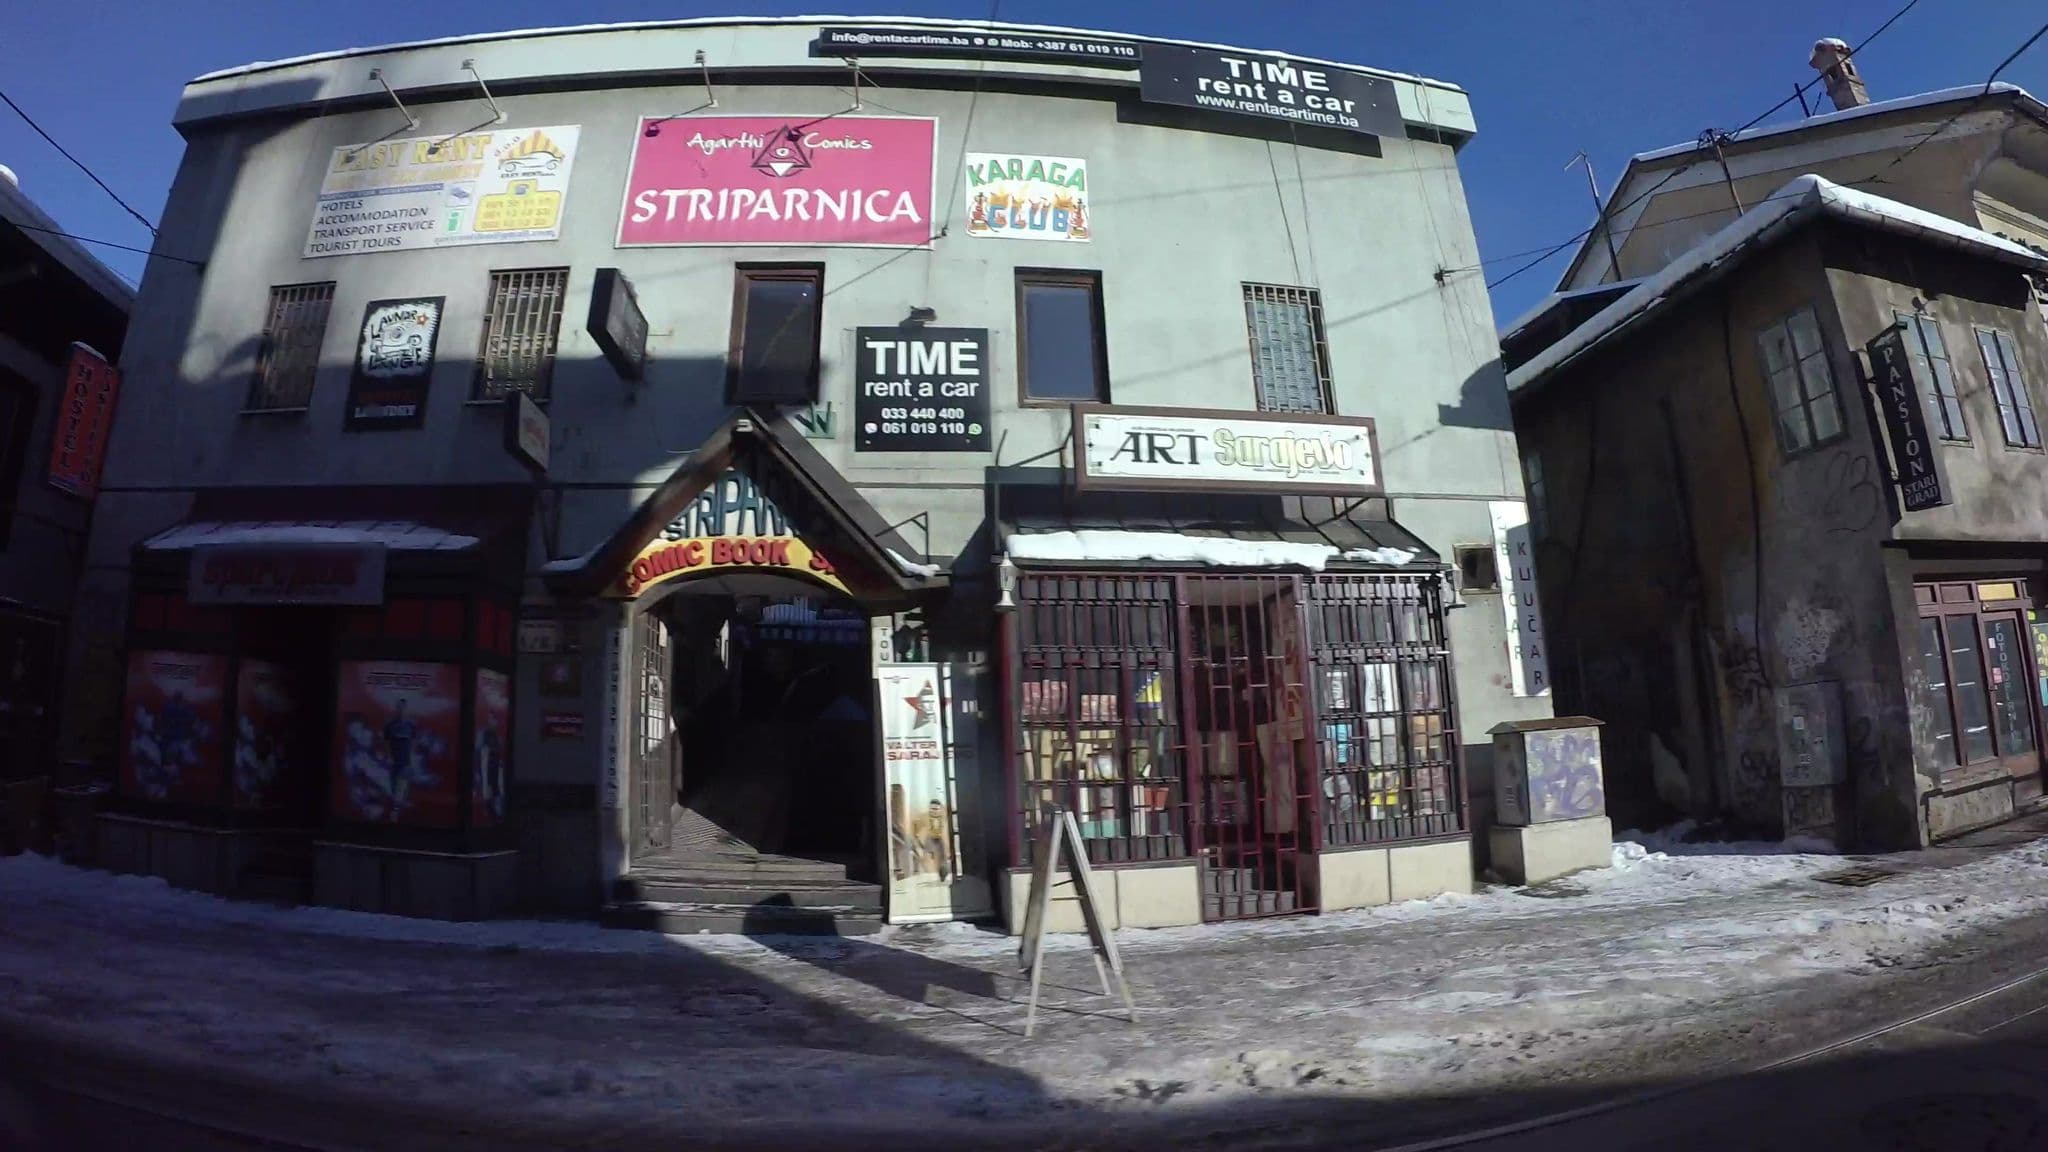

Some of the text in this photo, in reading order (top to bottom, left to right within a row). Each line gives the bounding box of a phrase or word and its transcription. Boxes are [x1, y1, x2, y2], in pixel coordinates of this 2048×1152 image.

[831, 32, 1135, 56] info@rentacartime.ba Mob: +387 61 019 110
[1220, 57, 1330, 92] TIME
[1198, 77, 1356, 114] rent a car
[1195, 94, 1359, 127] www.rentacartime.ba
[803, 132, 873, 150] Comics
[966, 158, 1086, 192] KARAGA
[317, 207, 429, 225] ACCOMMODATION
[321, 199, 363, 211] HOTELS
[631, 188, 922, 224] STRIPARNICA
[986, 191, 1074, 232] CLUB
[314, 220, 436, 239] TRANSPORT SERVICE
[310, 236, 402, 253] TOURIST TOURS
[866, 341, 980, 375] TIME
[865, 379, 980, 397] rent a car
[881, 408, 965, 419] 033 440 400
[1883, 347, 1926, 477] PANSION
[882, 422, 965, 434] 061 019 110
[1110, 432, 1208, 465] ART
[1905, 474, 1936, 494] STARI
[1907, 487, 1939, 507] GRAD
[624, 541, 704, 595] COMIC
[712, 538, 790, 566] BOOK
